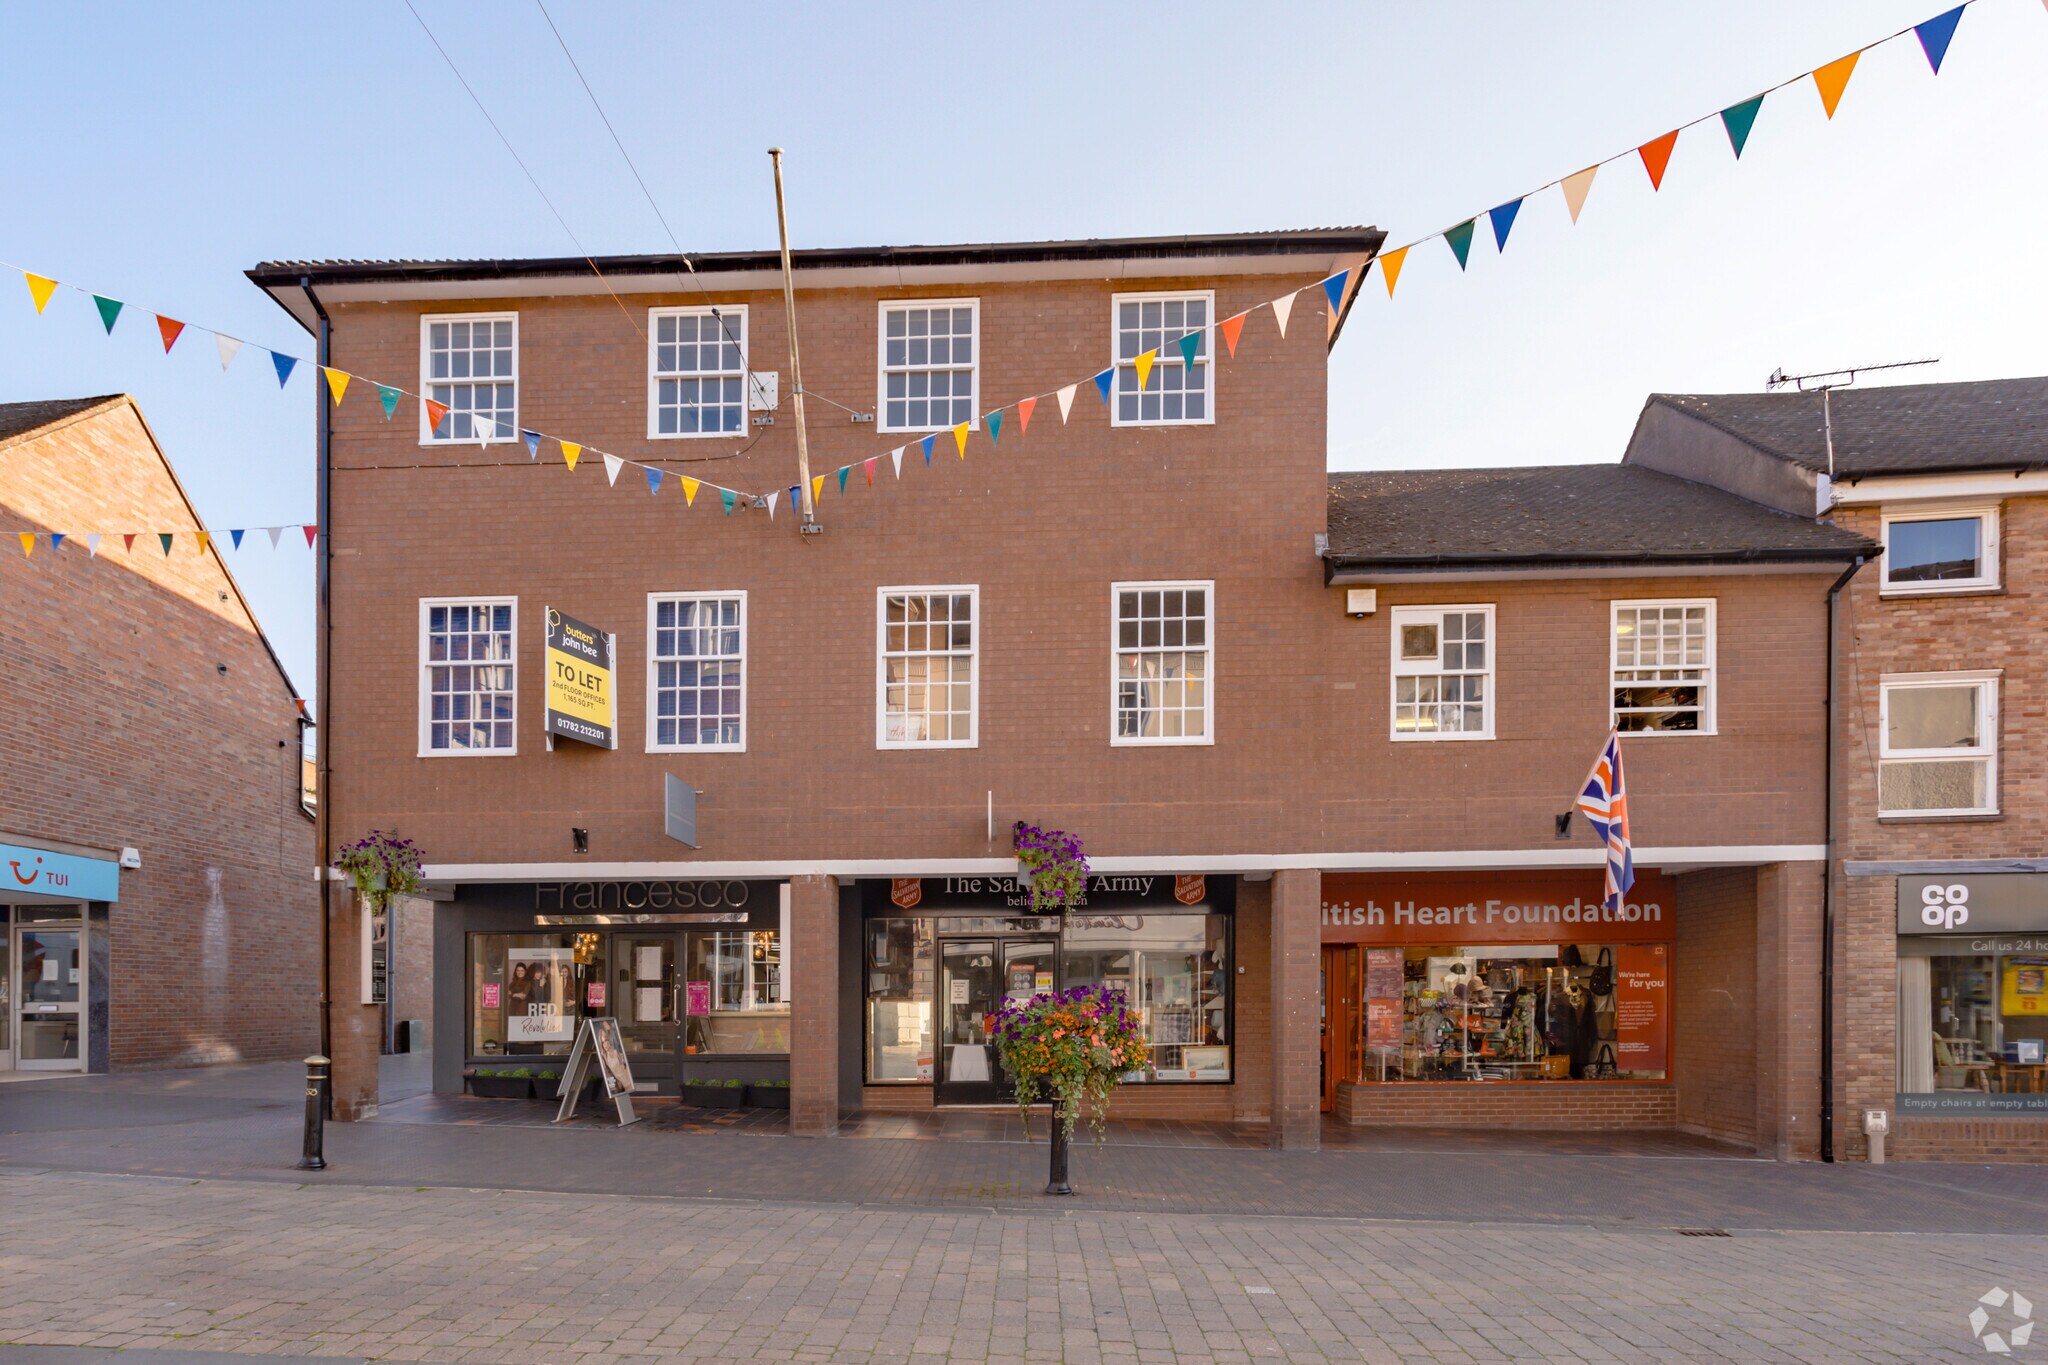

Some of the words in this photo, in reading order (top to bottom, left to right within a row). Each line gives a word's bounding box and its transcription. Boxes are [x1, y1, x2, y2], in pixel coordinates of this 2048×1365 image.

[566, 624, 594, 645] butters
[562, 634, 581, 652] john
[582, 644, 598, 658] bee
[555, 661, 575, 682] TO
[579, 670, 602, 693] LET
[552, 680, 564, 690] 2nd
[564, 684, 583, 697] FLOOR
[583, 692, 606, 705] OFFICES
[557, 718, 579, 733] 01782
[580, 724, 605, 740] 212201
[46, 872, 69, 887] TUI
[941, 877, 981, 894] The
[1092, 875, 1155, 897] Army
[535, 880, 749, 909] Francesco
[1321, 900, 1385, 926] itish
[1394, 901, 1477, 925] Heart
[1971, 940, 1995, 951] Call
[1998, 943, 2013, 951] us
[2015, 939, 2032, 951] 24
[1629, 978, 1643, 987] for
[1645, 980, 1665, 990] you
[528, 1003, 557, 1017] RED
[1904, 1098, 1938, 1109] Empty
[1941, 1098, 1972, 1107] chairs
[1975, 1099, 1986, 1107] at
[1990, 1100, 2026, 1110] empty
